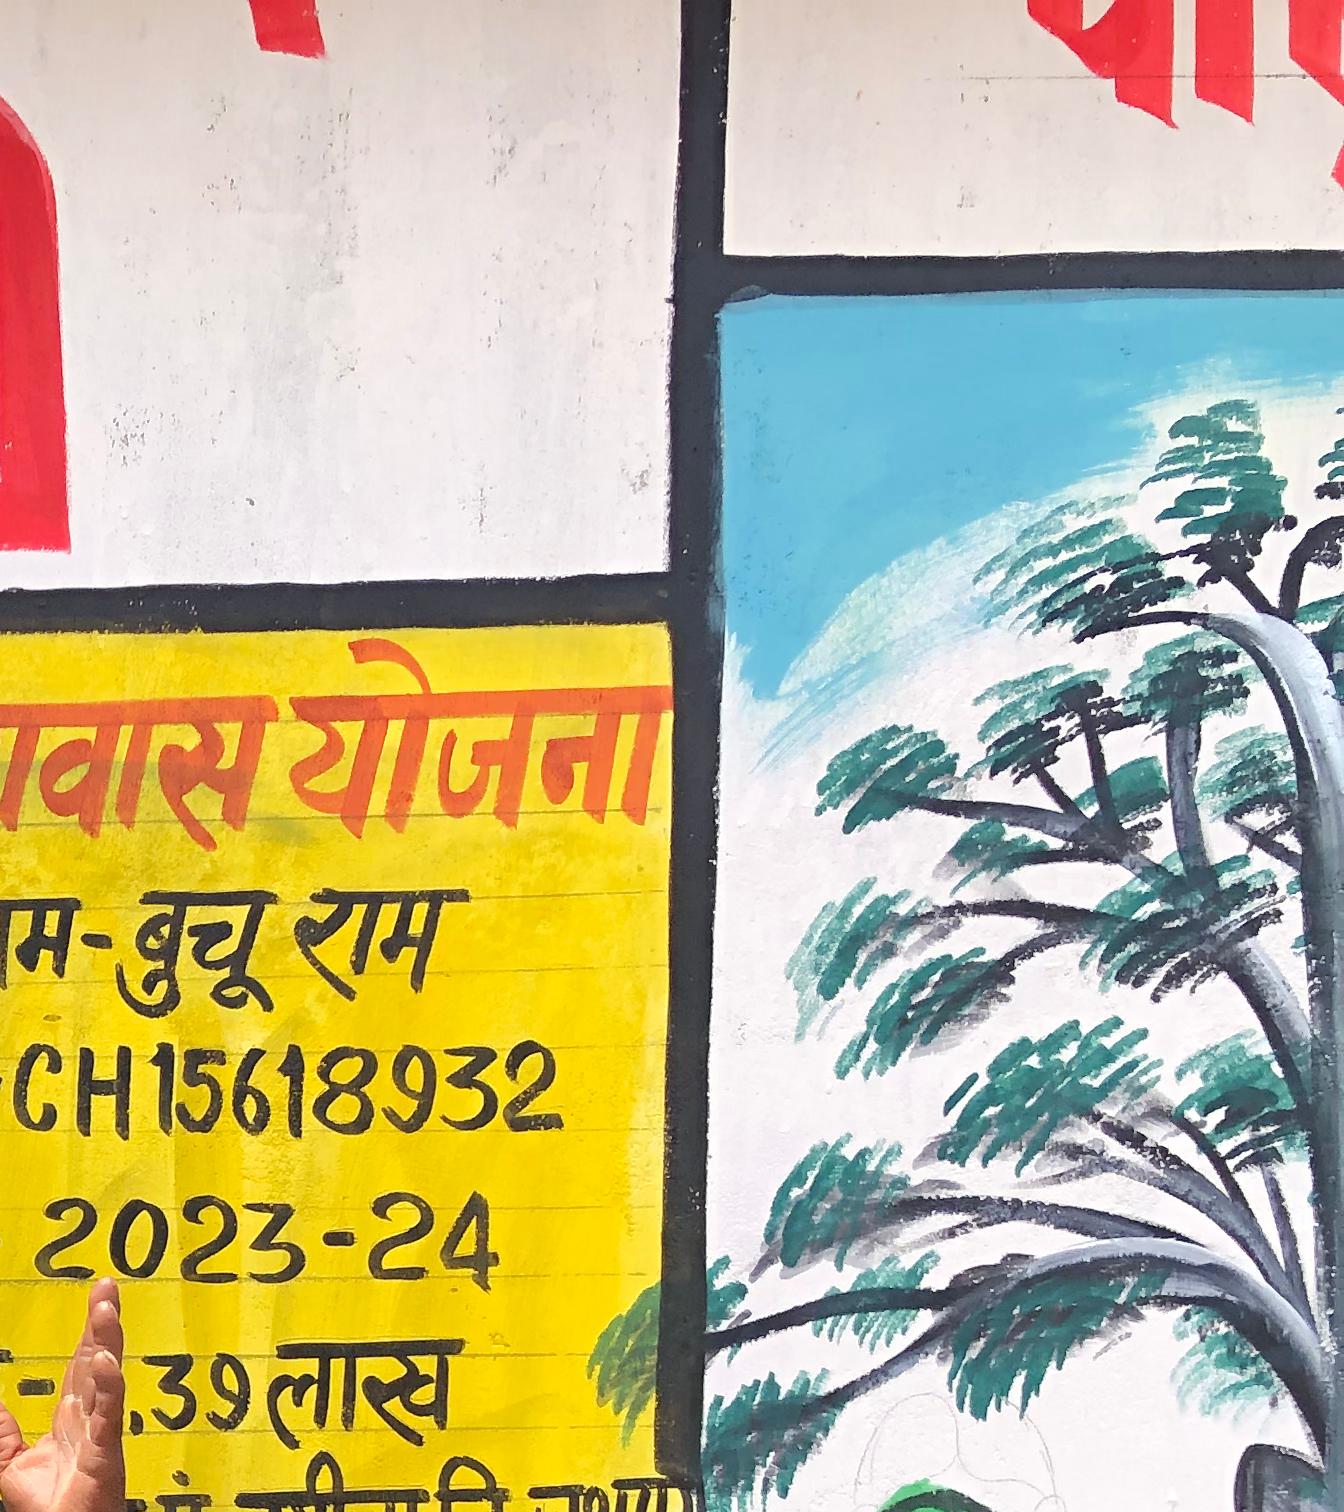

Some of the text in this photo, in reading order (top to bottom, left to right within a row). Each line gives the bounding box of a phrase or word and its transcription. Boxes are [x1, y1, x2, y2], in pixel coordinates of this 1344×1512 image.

[289, 638, 673, 839] योजना
[293, 888, 470, 1002] राम
[33, 1191, 501, 1292] 2023-24
[266, 1338, 465, 1450] लाख
